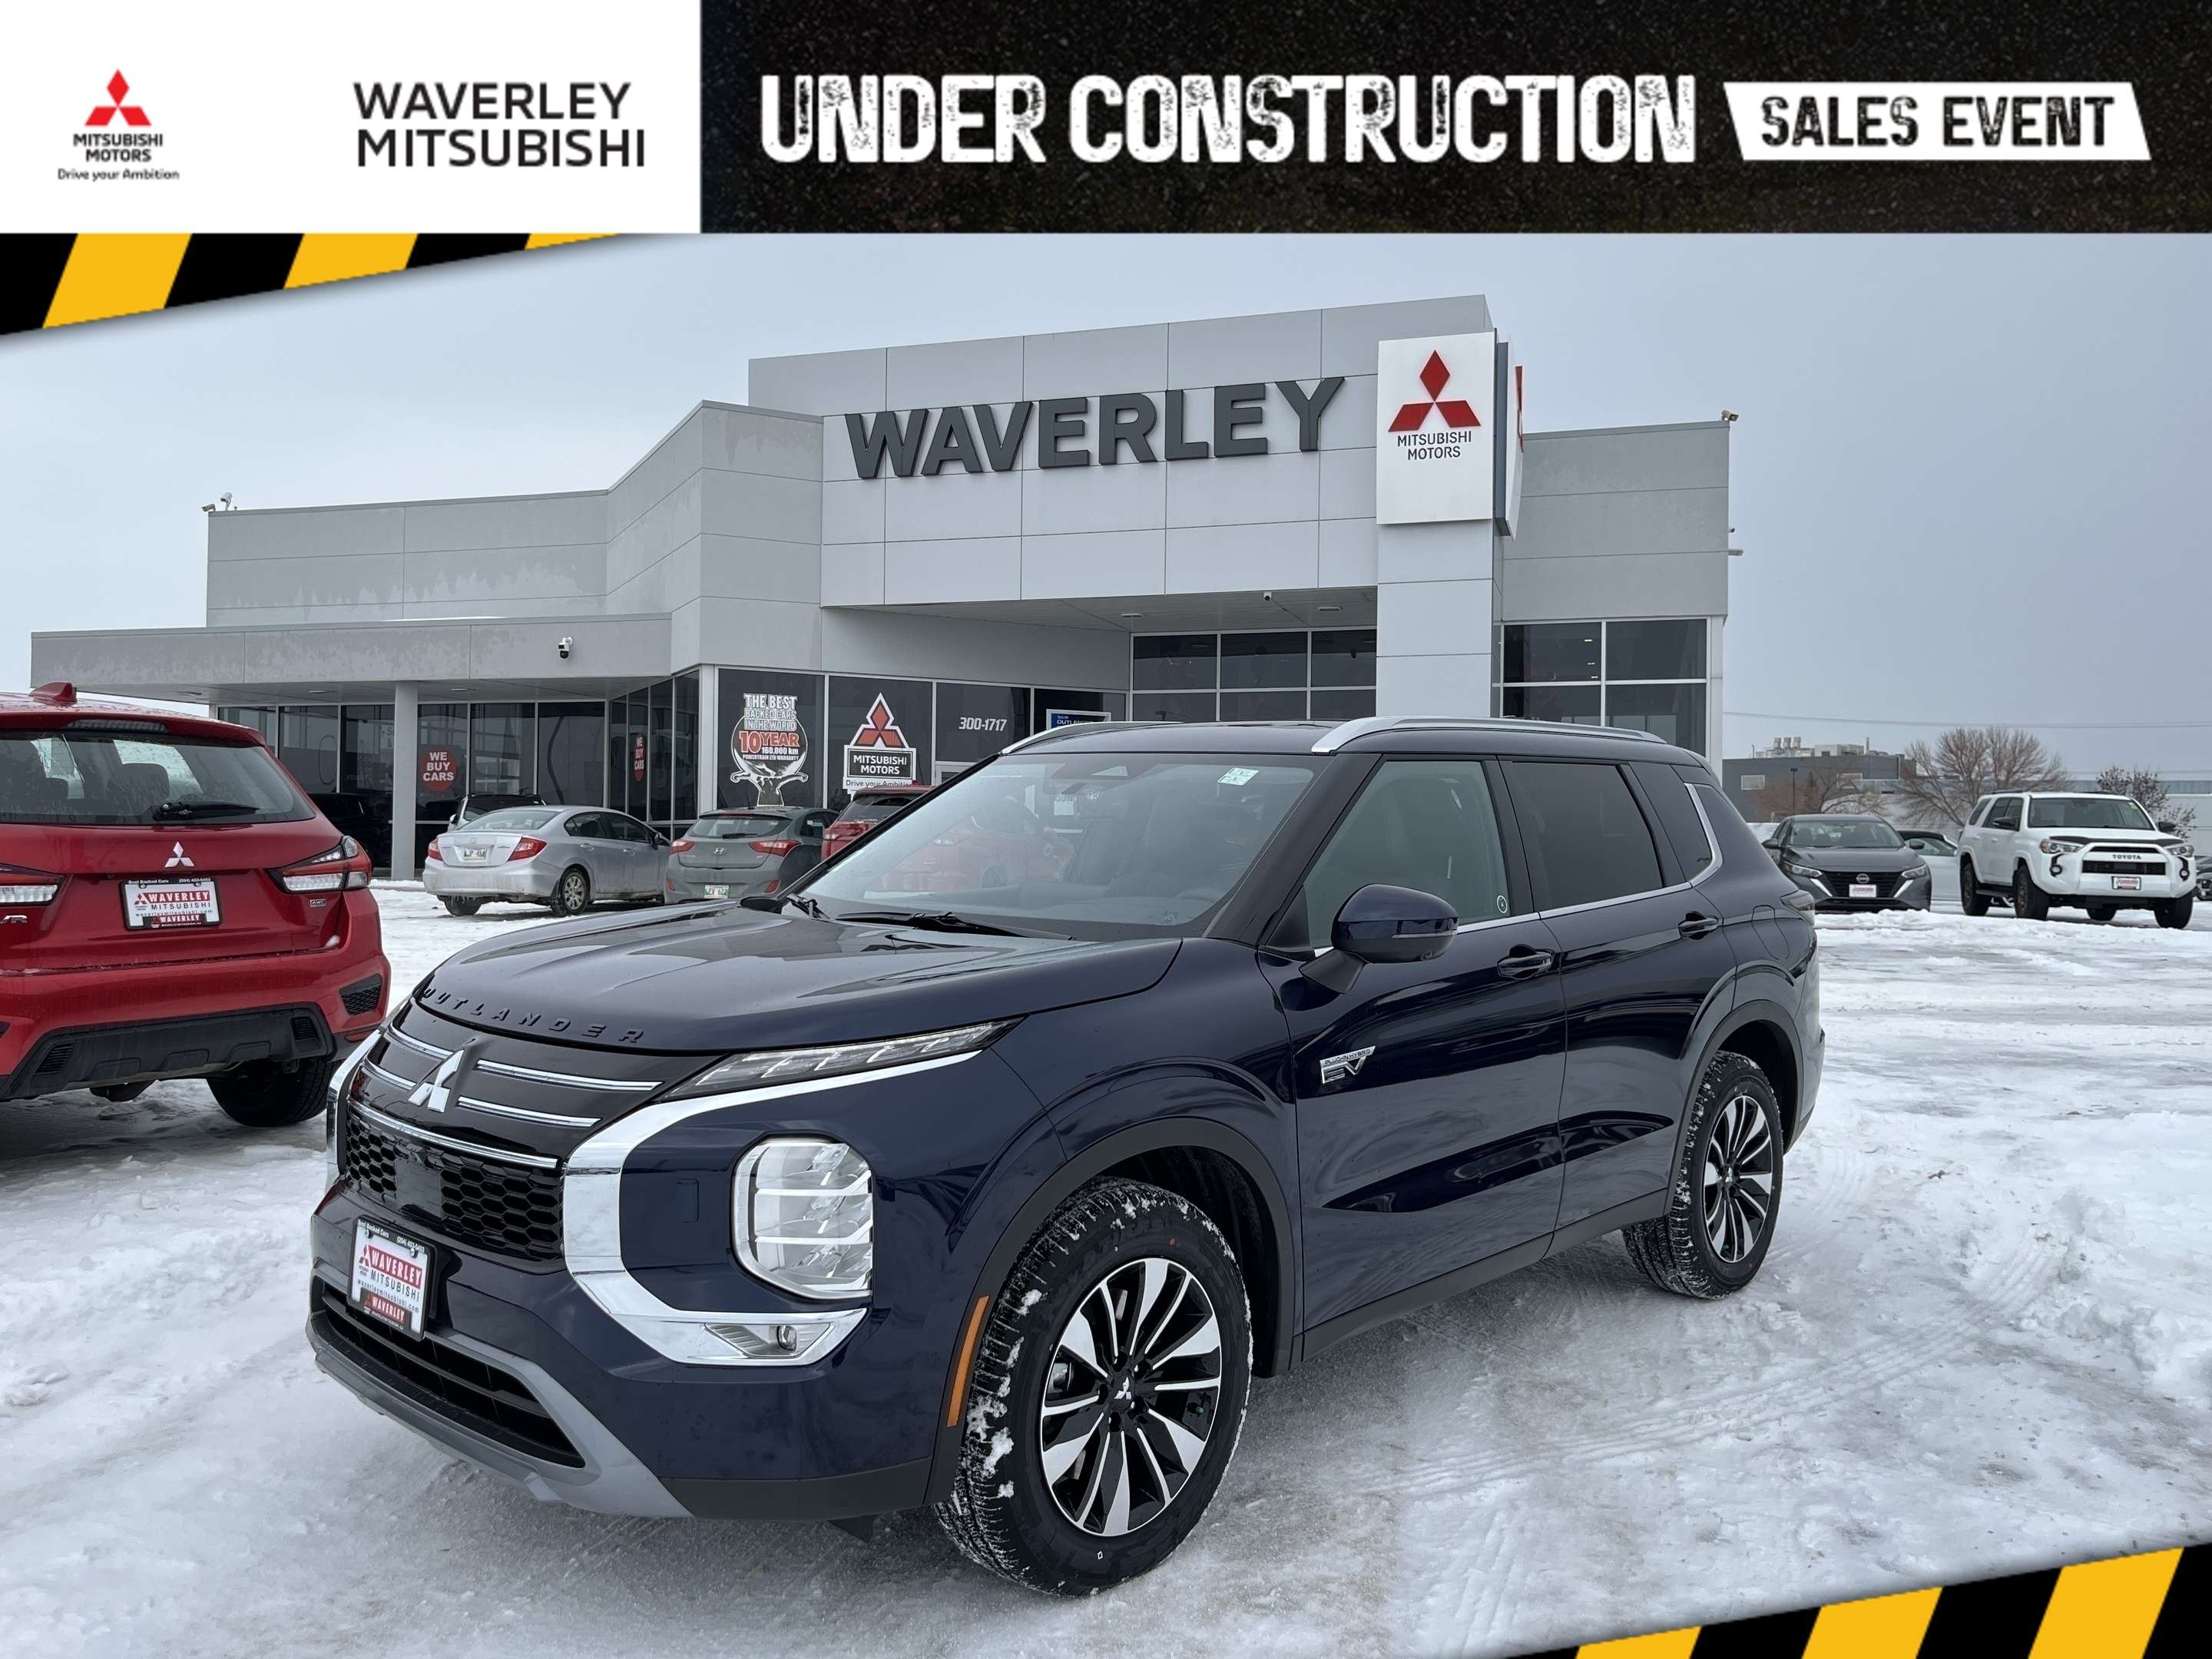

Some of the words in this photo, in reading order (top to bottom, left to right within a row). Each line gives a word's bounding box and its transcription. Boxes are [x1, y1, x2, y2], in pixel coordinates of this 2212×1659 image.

[845, 377, 1346, 479] WAVERLEY
[1397, 431, 1472, 447] MITSUBISHI
[1407, 446, 1461, 461] MOTORS
[743, 694, 767, 708] THE
[769, 695, 797, 710] BEST
[746, 709, 774, 719] BACKED
[777, 710, 796, 720] CARS
[746, 720, 753, 730] IN
[753, 720, 768, 730] THE
[770, 720, 796, 730] WORLD
[959, 717, 1008, 731] 300-1717
[740, 731, 761, 753] 10
[760, 732, 800, 747] YEAR
[430, 752, 448, 761] WE
[853, 755, 906, 766] MITSUBISHI
[427, 762, 451, 771] BUY
[861, 765, 899, 774] MOTORS
[423, 772, 454, 781] CARS
[148, 892, 209, 902] WAVERLEY
[160, 914, 200, 922] WAVERLEY
[422, 988, 644, 1044] OUTLANDER
[372, 1249, 422, 1286] WAVERLEY
[371, 1270, 420, 1302] MITSUBISHI
[373, 1296, 405, 1323] WAVERLEY
